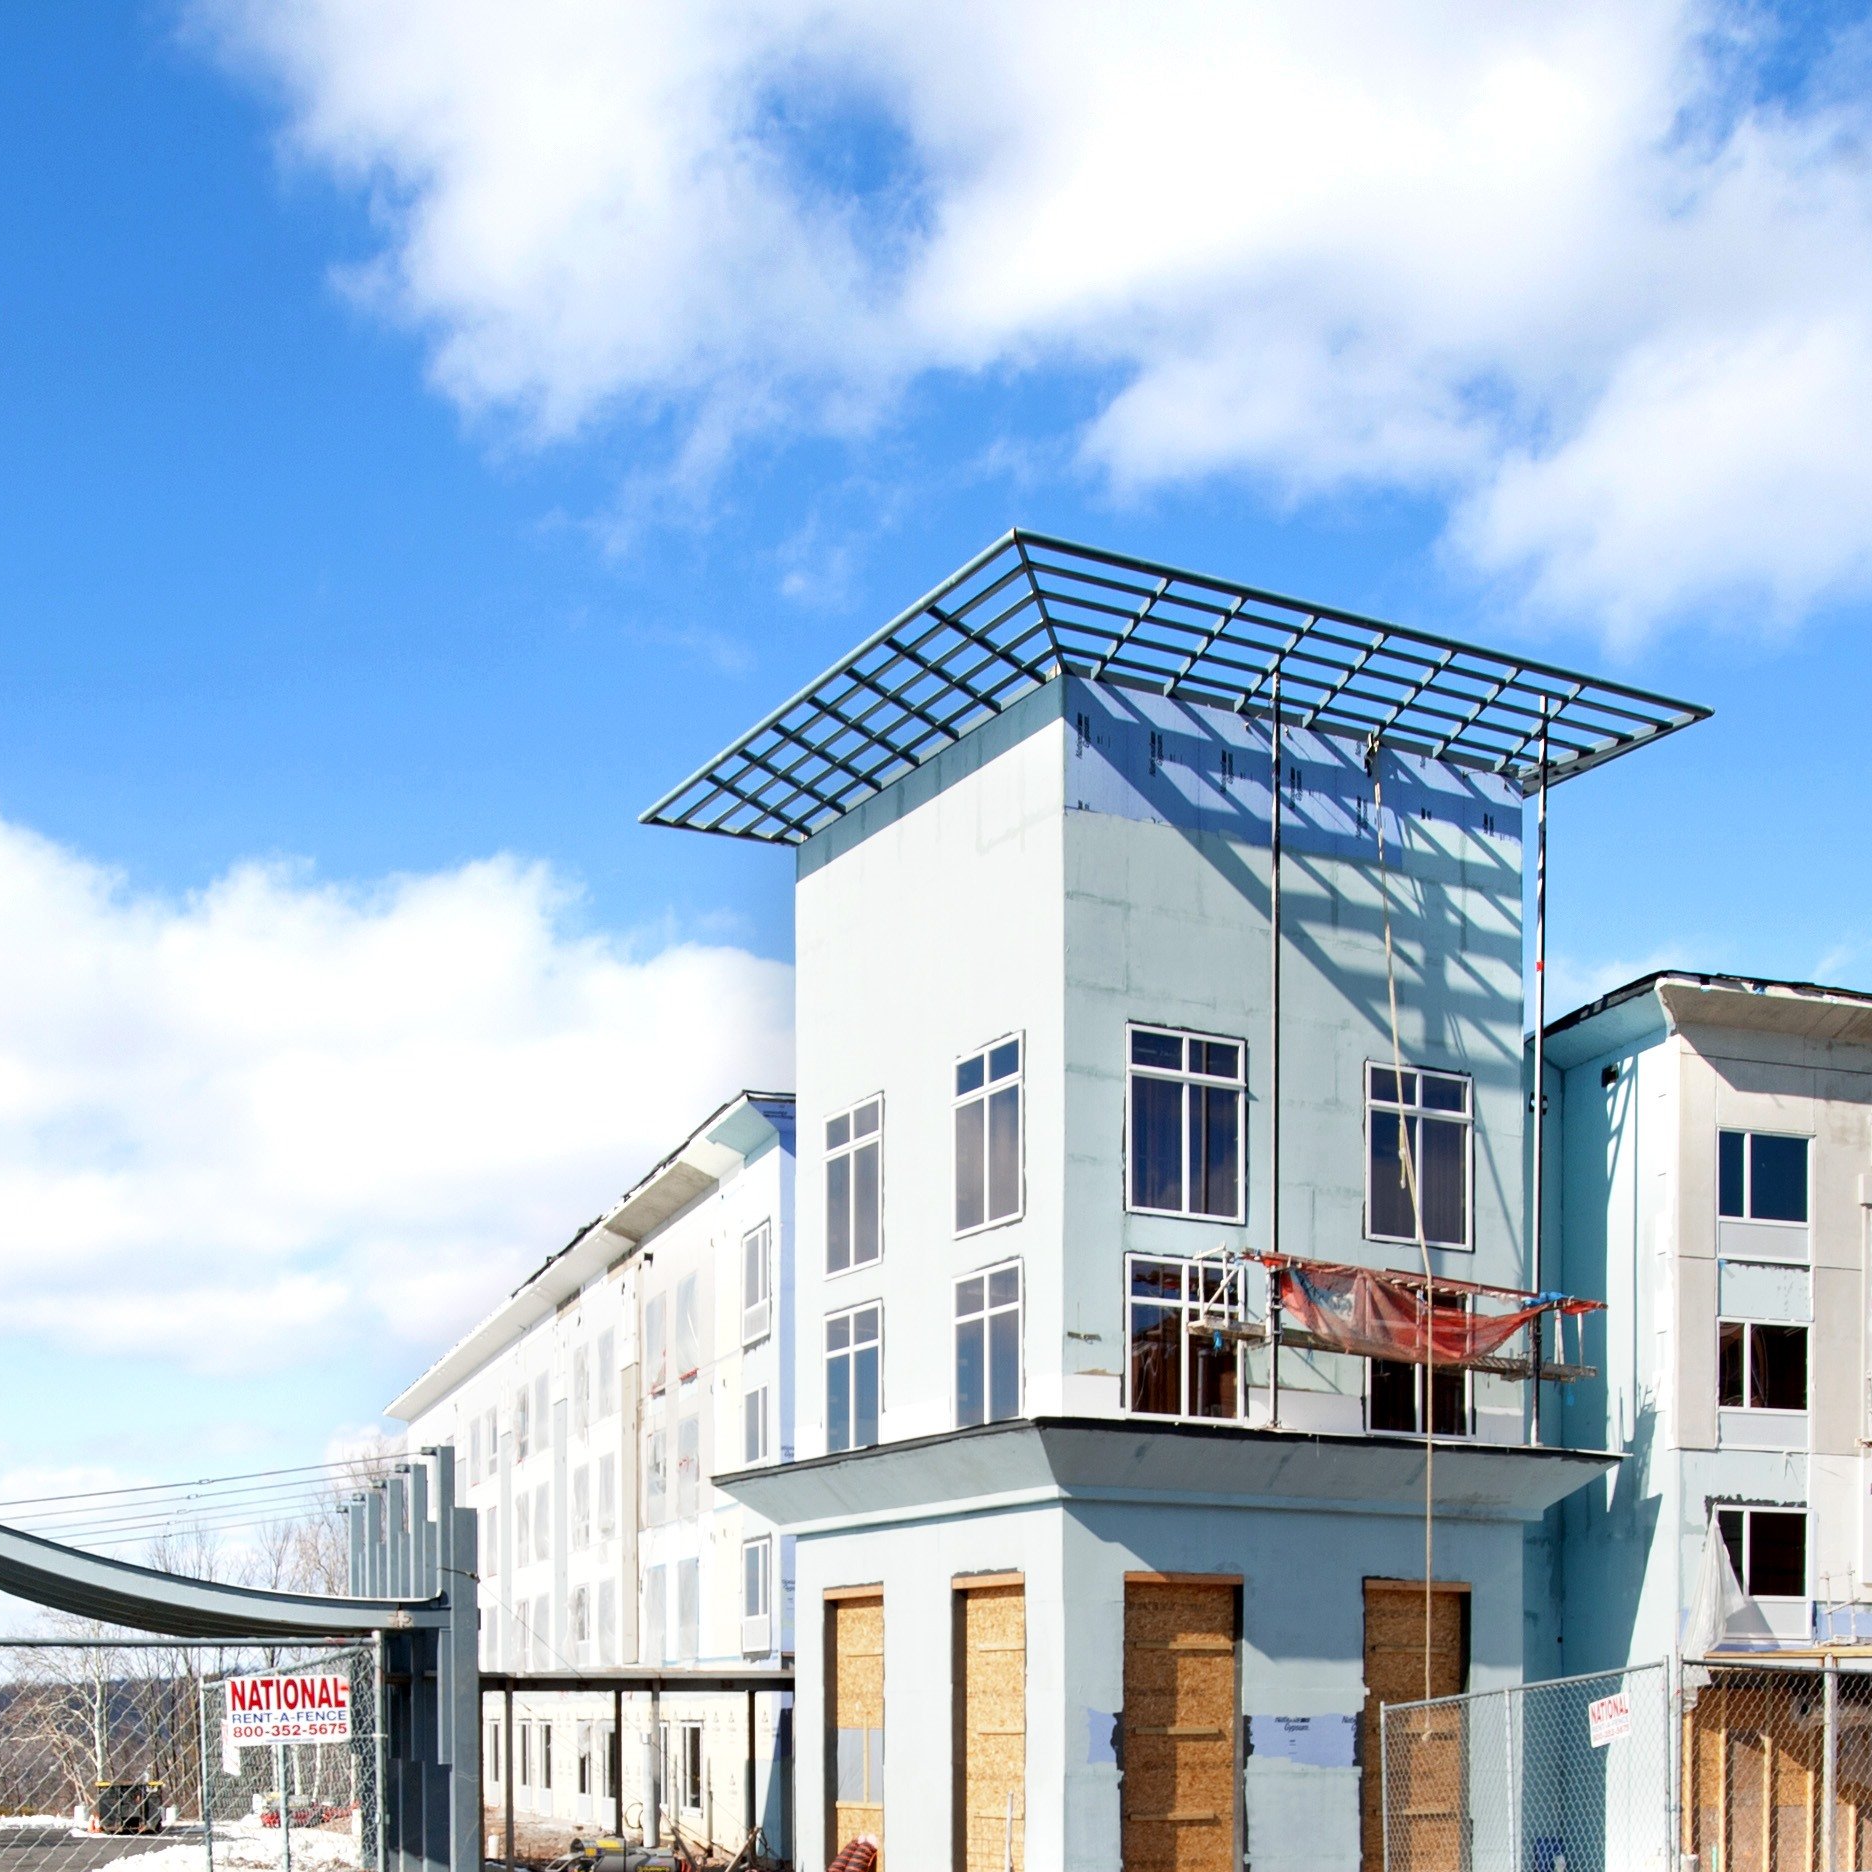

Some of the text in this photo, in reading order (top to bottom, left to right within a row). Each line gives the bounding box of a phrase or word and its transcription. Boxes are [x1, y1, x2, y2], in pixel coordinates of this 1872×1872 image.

[231, 1678, 346, 1711] NATIONAL
[232, 1710, 346, 1724] RENT-A-FENCE
[233, 1723, 347, 1738] 800-352-5675
